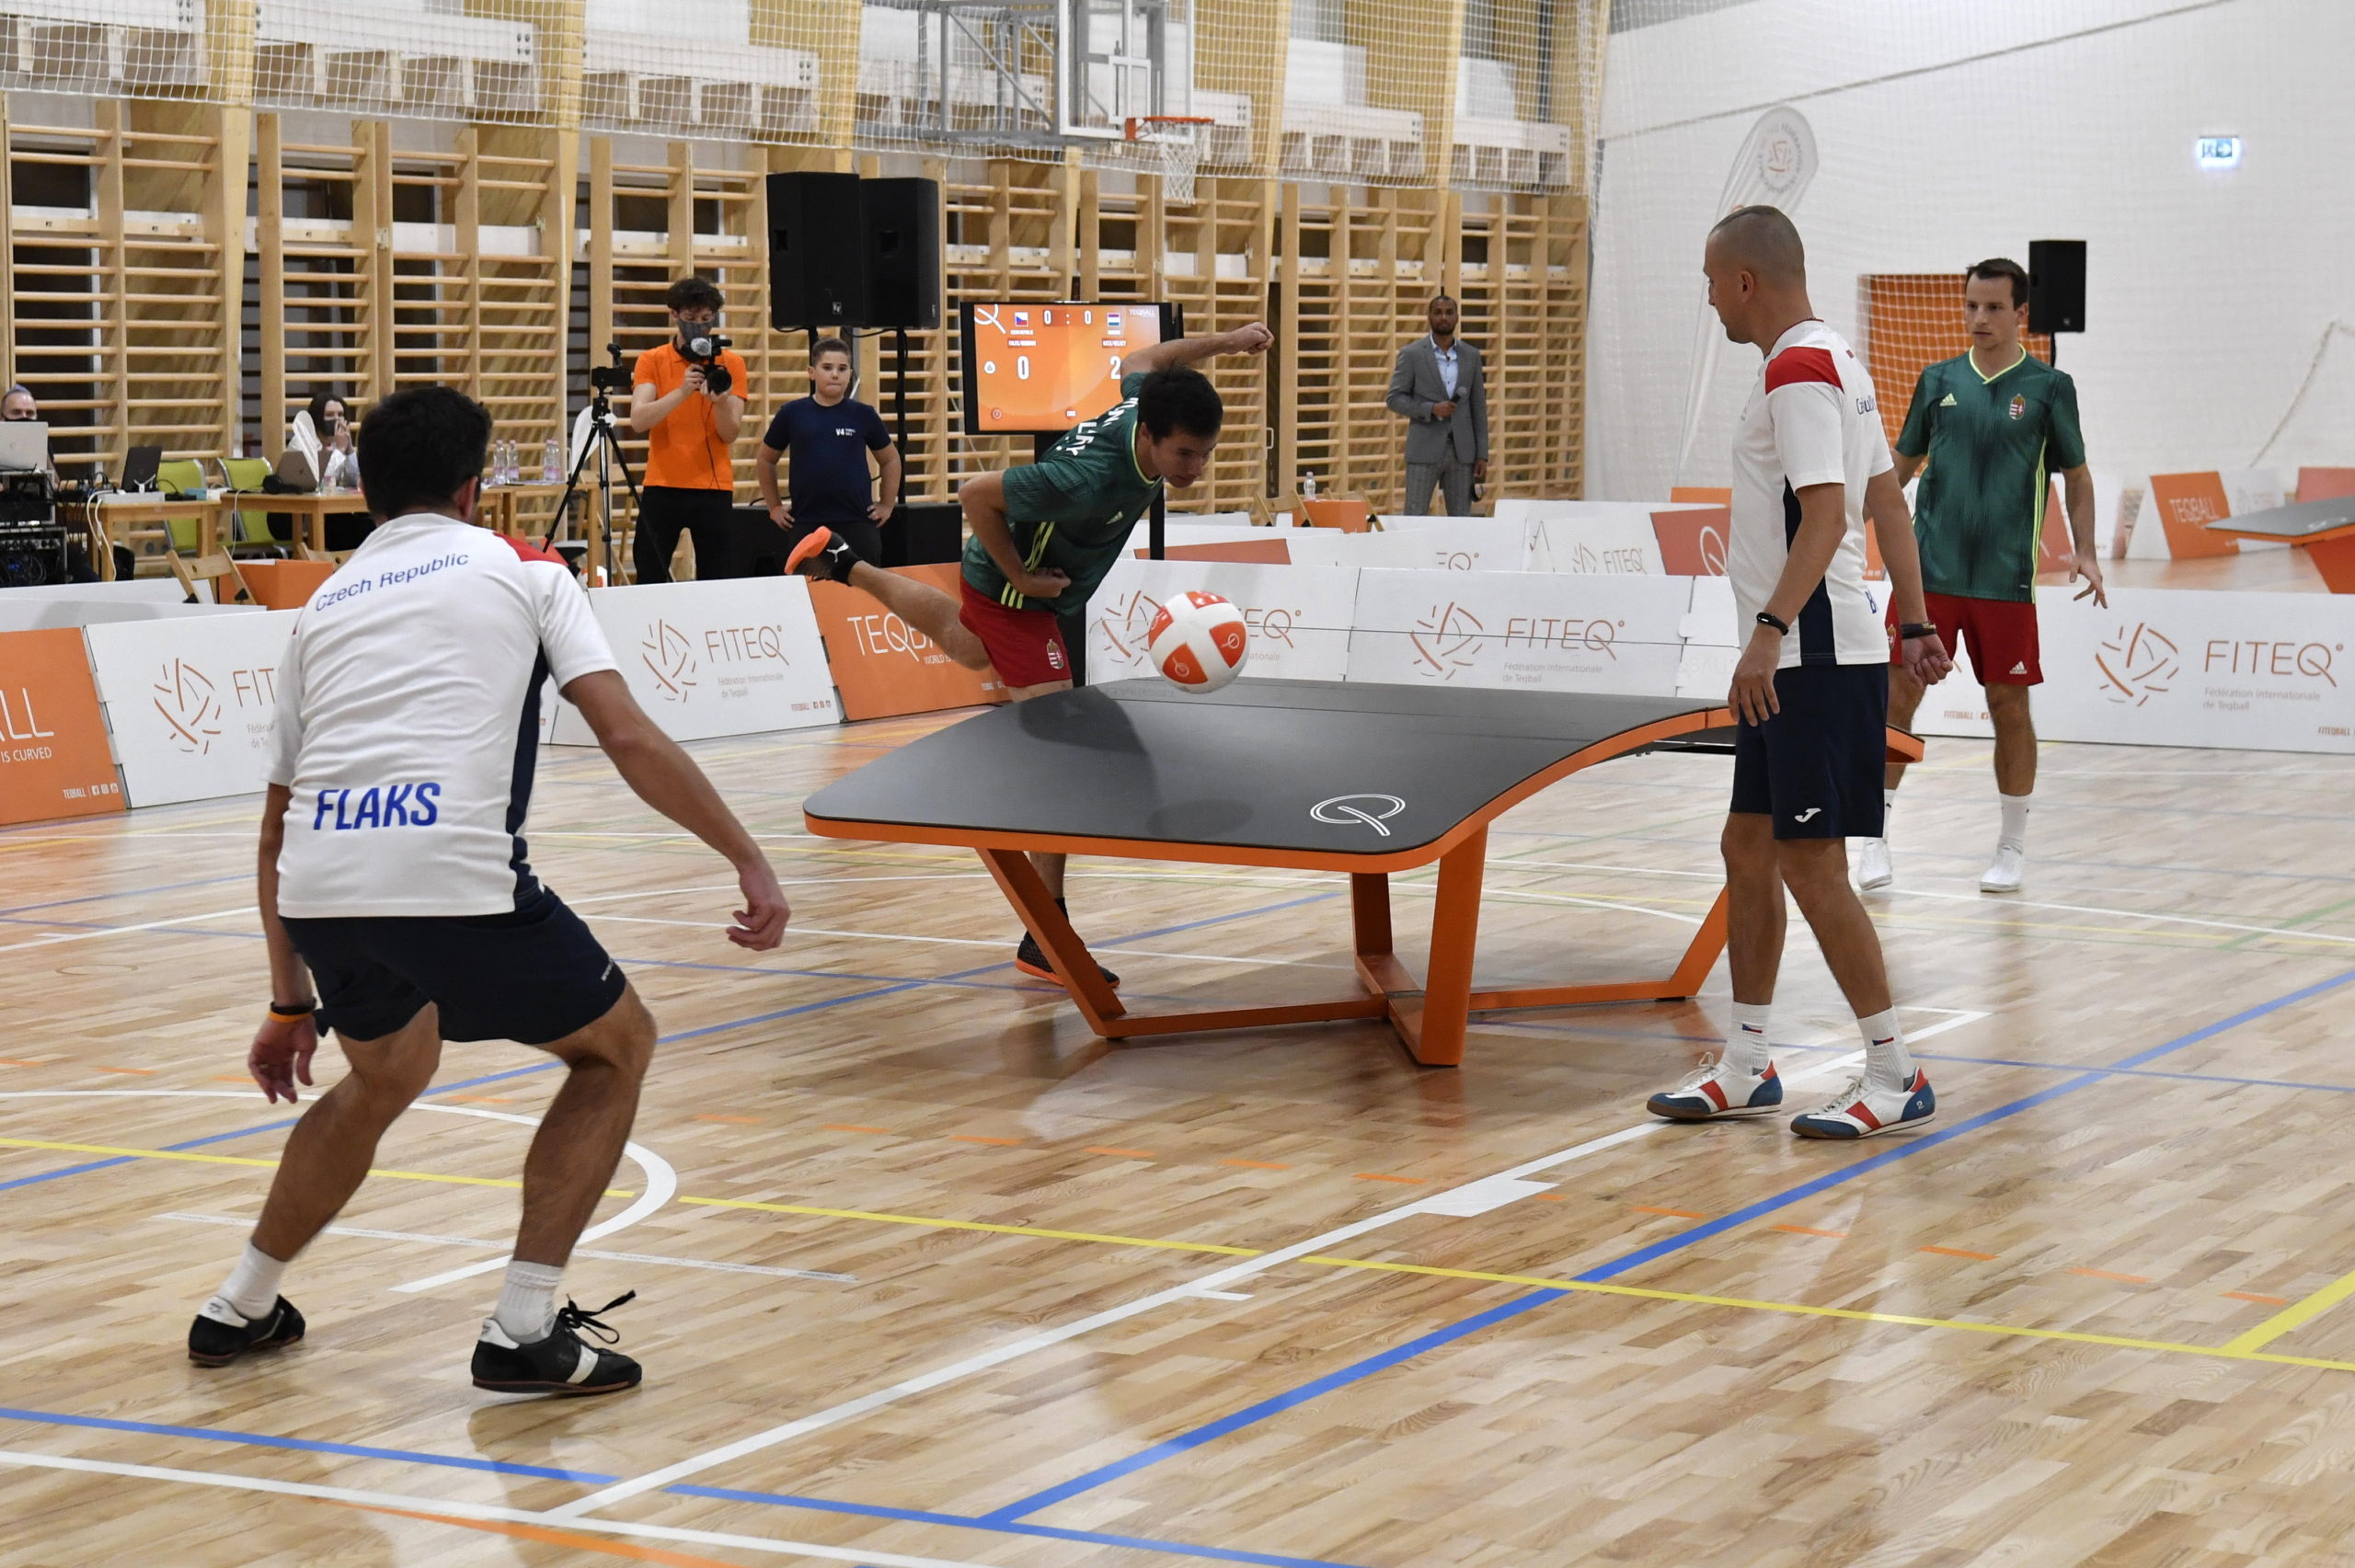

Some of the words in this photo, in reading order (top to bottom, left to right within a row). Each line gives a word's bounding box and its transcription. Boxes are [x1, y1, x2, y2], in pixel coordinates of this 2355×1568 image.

[1043, 310, 1051, 325] 0
[1084, 310, 1092, 325] 0
[1017, 355, 1030, 381] 0
[1109, 355, 1121, 380] 2
[316, 578, 372, 612] Czech
[380, 554, 469, 589] Republic
[705, 624, 789, 666] FITEQ
[1504, 617, 1617, 661] FITEQ
[2204, 640, 2338, 688] FITEQ
[233, 667, 276, 708] FIT
[1515, 674, 1543, 684] Teqball
[2204, 687, 2254, 698] Fédération
[2202, 700, 2215, 710] de
[2218, 701, 2251, 712] Teqball
[2, 750, 11, 763] IS
[13, 746, 52, 762] CURVED
[314, 782, 442, 830] FLAKS
